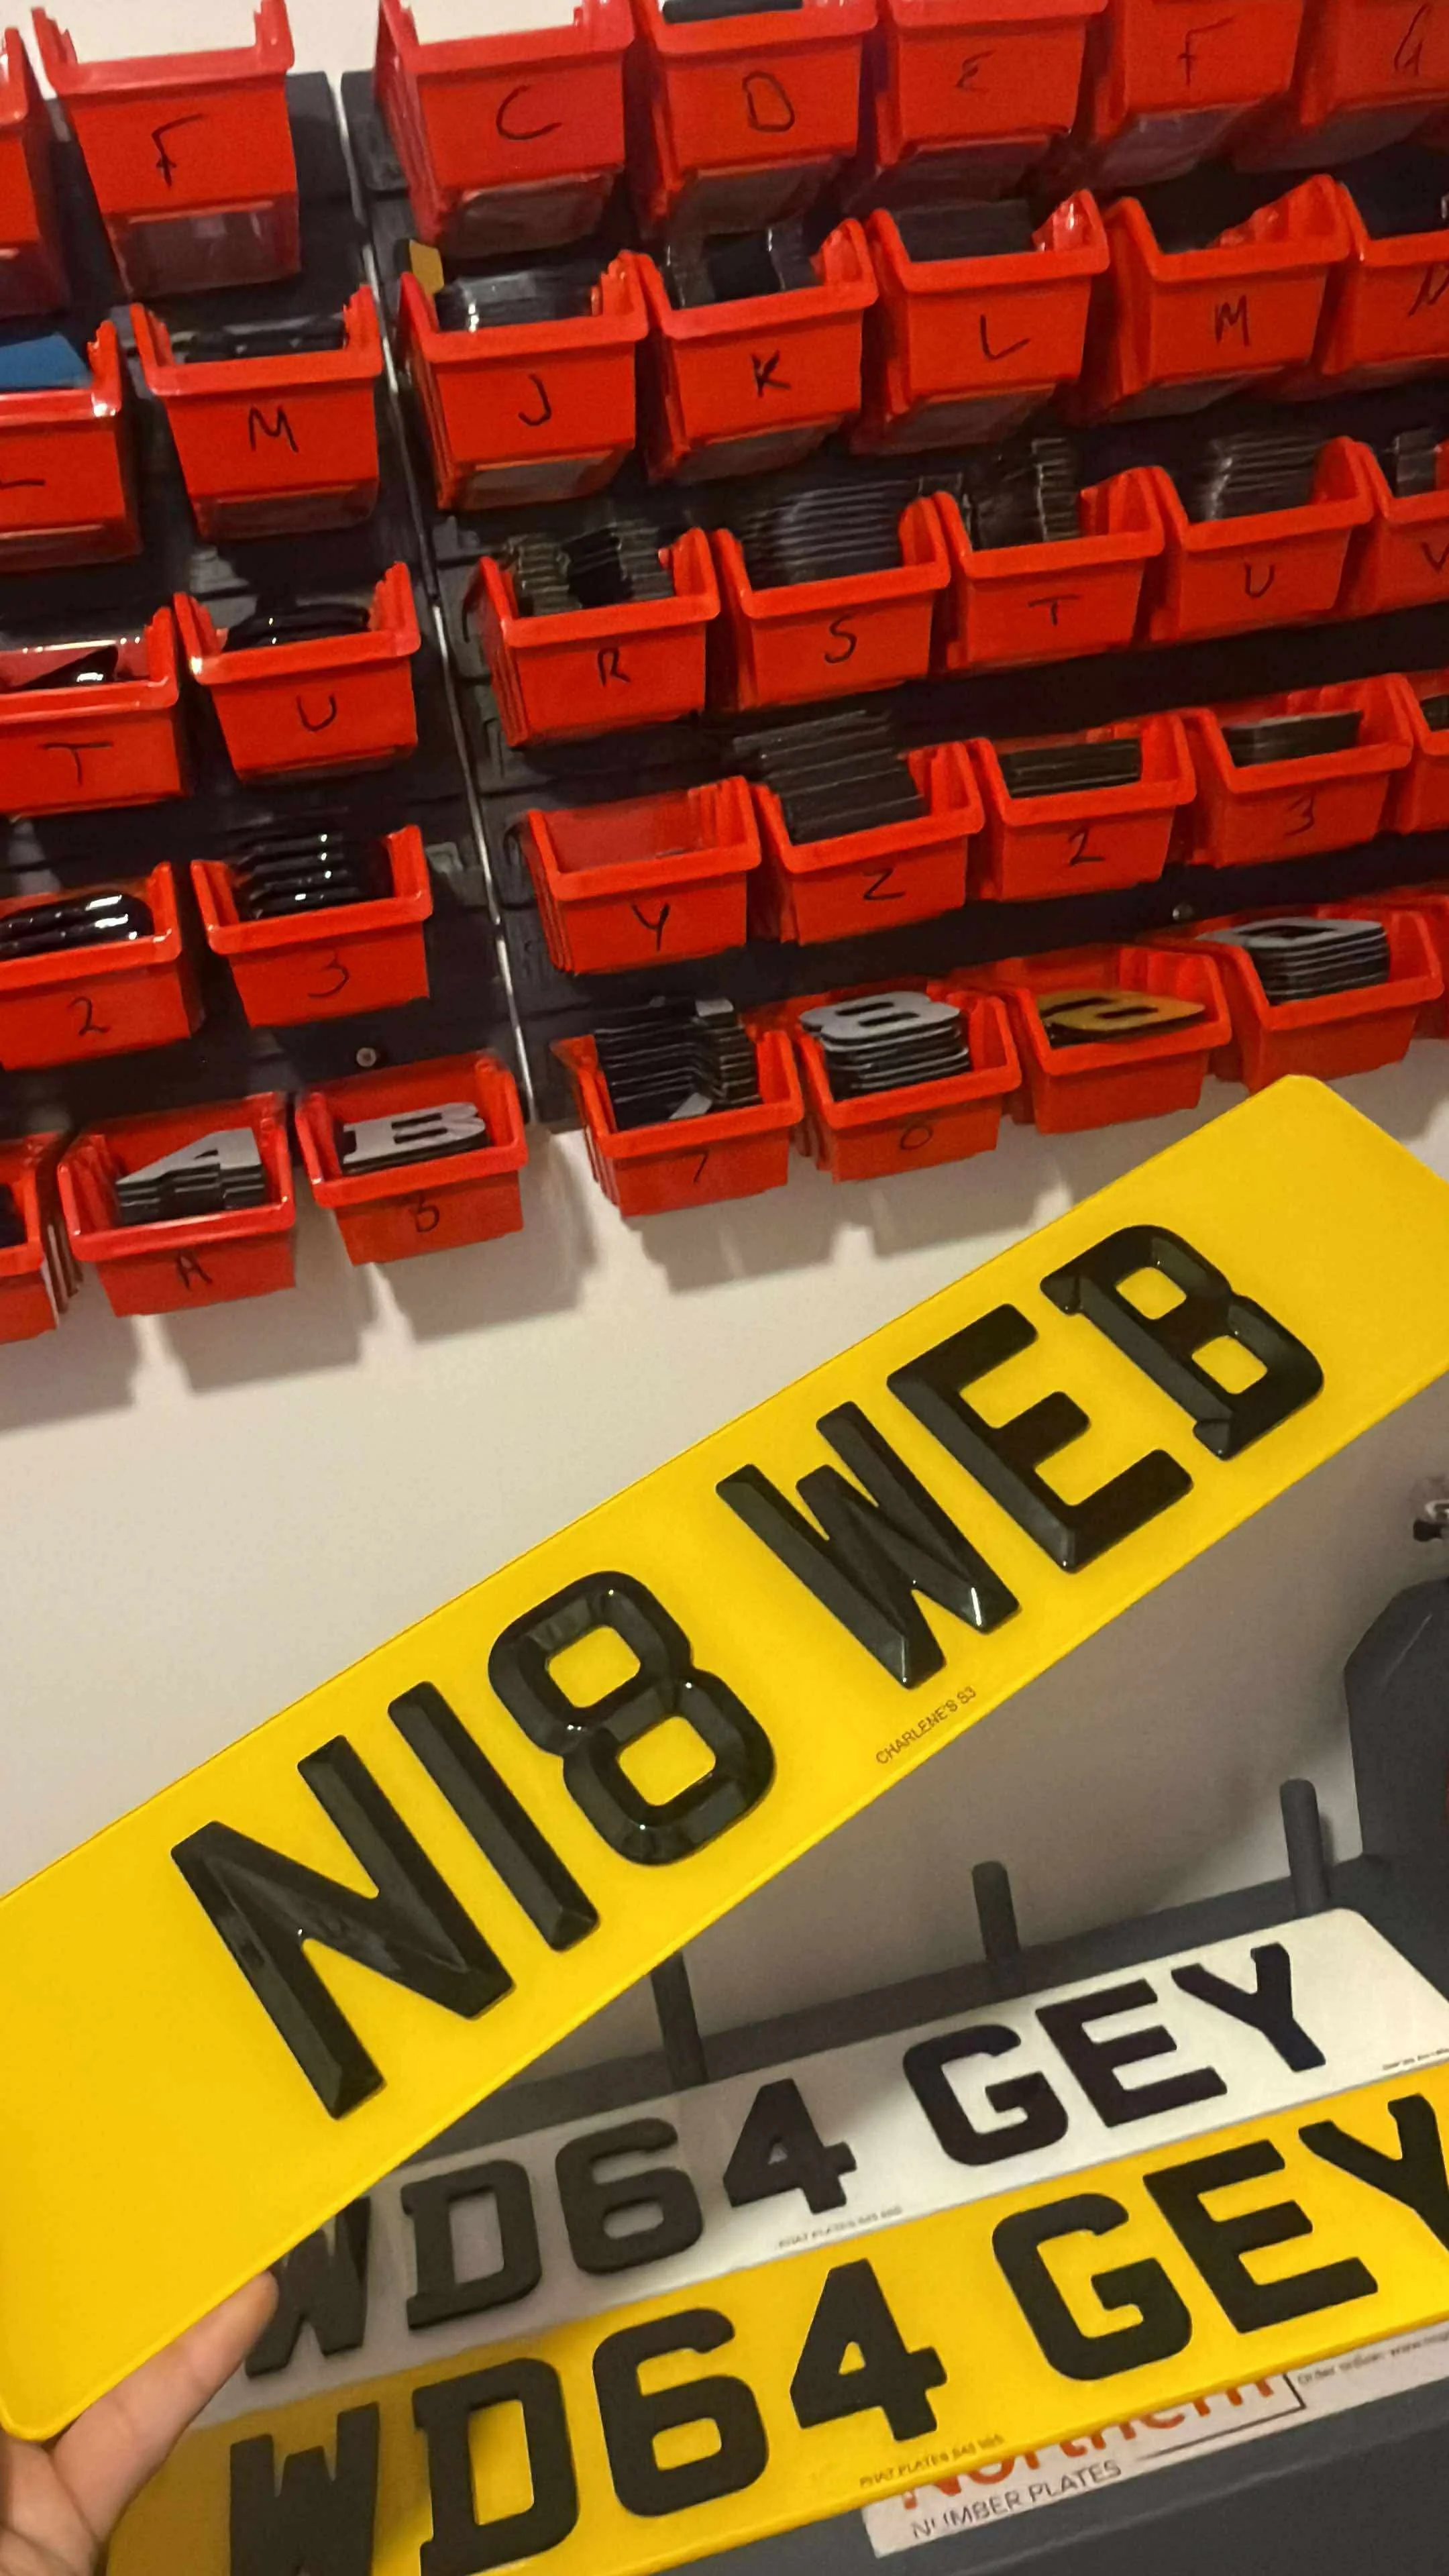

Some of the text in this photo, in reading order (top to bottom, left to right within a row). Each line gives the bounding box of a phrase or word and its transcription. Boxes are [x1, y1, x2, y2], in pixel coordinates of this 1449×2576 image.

[1179, 17, 1234, 87] F
[496, 85, 561, 141] C
[742, 70, 796, 132] D
[151, 113, 203, 188] F
[980, 314, 1031, 361] L
[1215, 294, 1250, 347] M
[751, 350, 792, 398] K
[519, 373, 551, 427] J
[248, 405, 299, 453] M
[1244, 562, 1275, 598] U
[1028, 593, 1081, 626] T
[824, 614, 858, 665] S
[597, 646, 631, 687] R
[296, 694, 337, 732] U
[42, 742, 114, 786] T
[1066, 826, 1106, 867] 2
[631, 901, 669, 951] Y
[307, 951, 350, 1000] 3
[68, 996, 111, 1037] 2
[176, 1249, 213, 1291] A
[718, 1224, 1324, 1690] WEB
[875, 1699, 959, 1764] CHARLENE'S
[244, 1941, 1326, 2379] WD64 GEY
[229, 2257, 948, 2576] WD64
[991, 2092, 1449, 2381] GEY
[1028, 2459, 1123, 2504] PLATES
